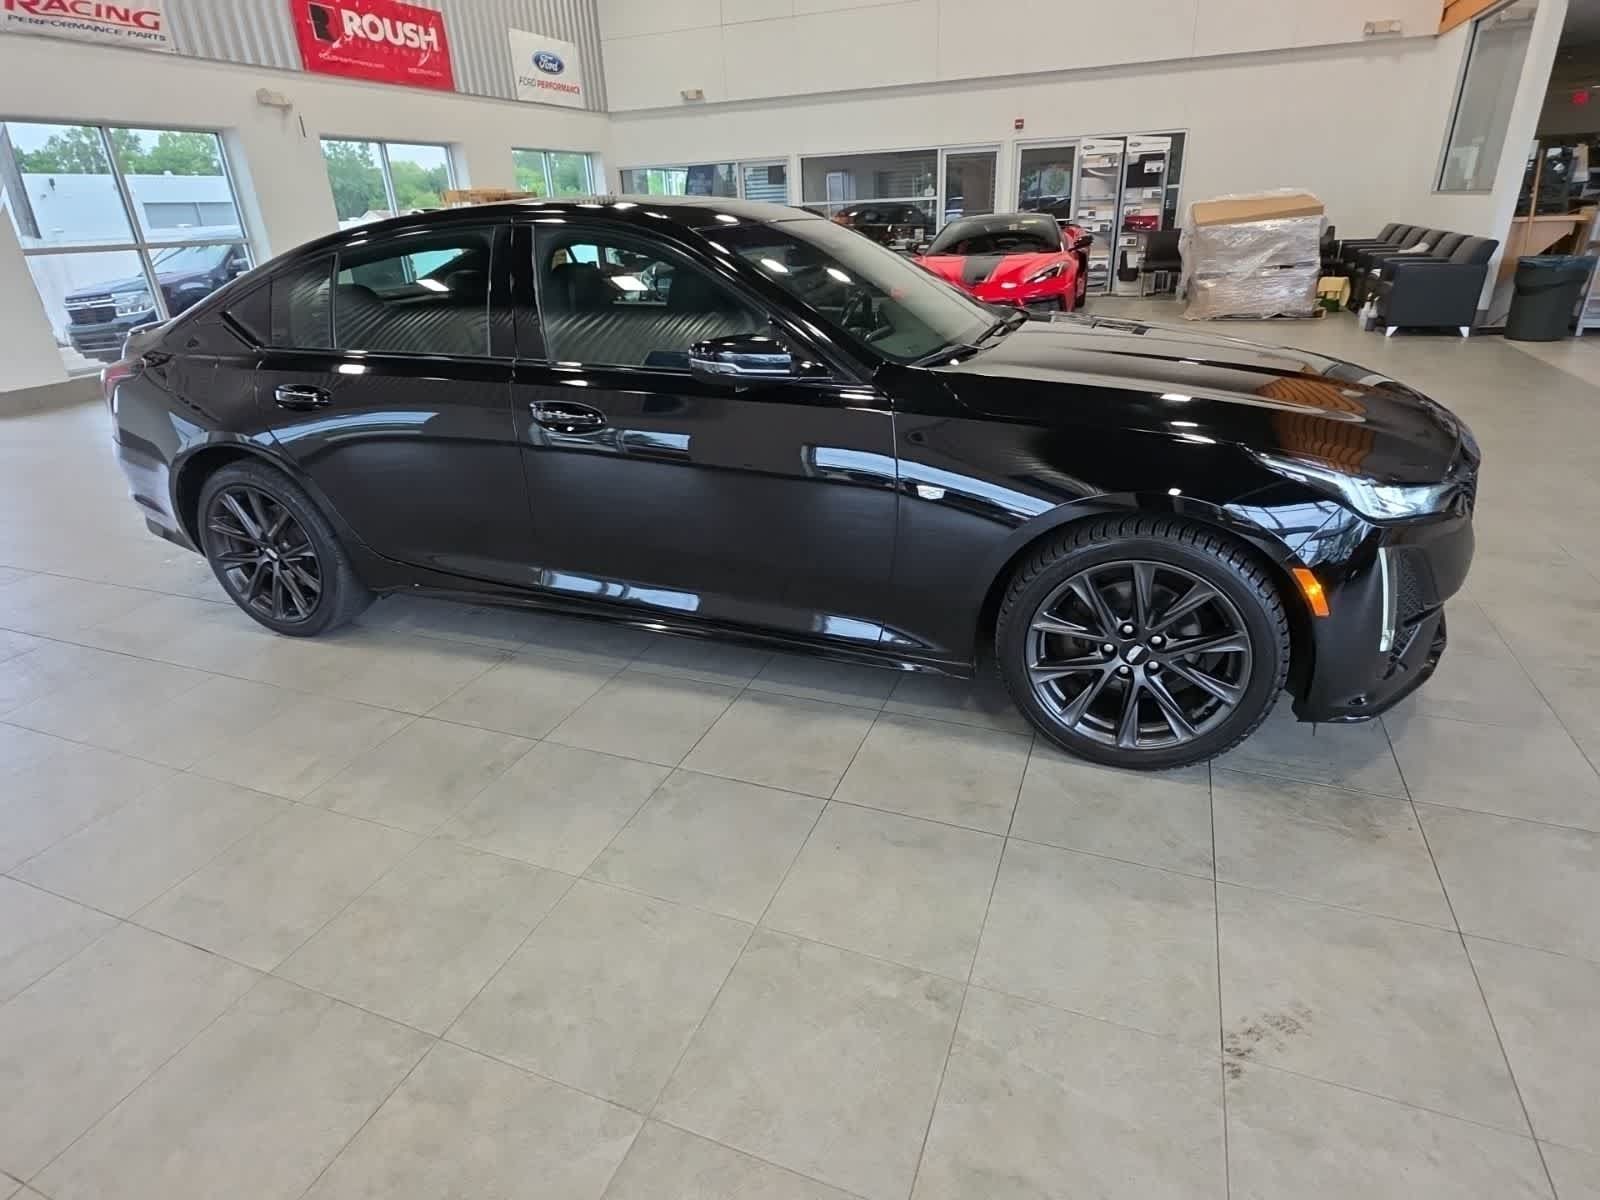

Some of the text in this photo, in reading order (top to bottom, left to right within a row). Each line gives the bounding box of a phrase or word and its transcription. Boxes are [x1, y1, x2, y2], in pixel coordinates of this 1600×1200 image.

[4, 0, 160, 30] RACING
[8, 15, 166, 41] PERFORMANCE PARTS
[341, 9, 439, 51] ROUSH
[539, 54, 558, 71] Ford
